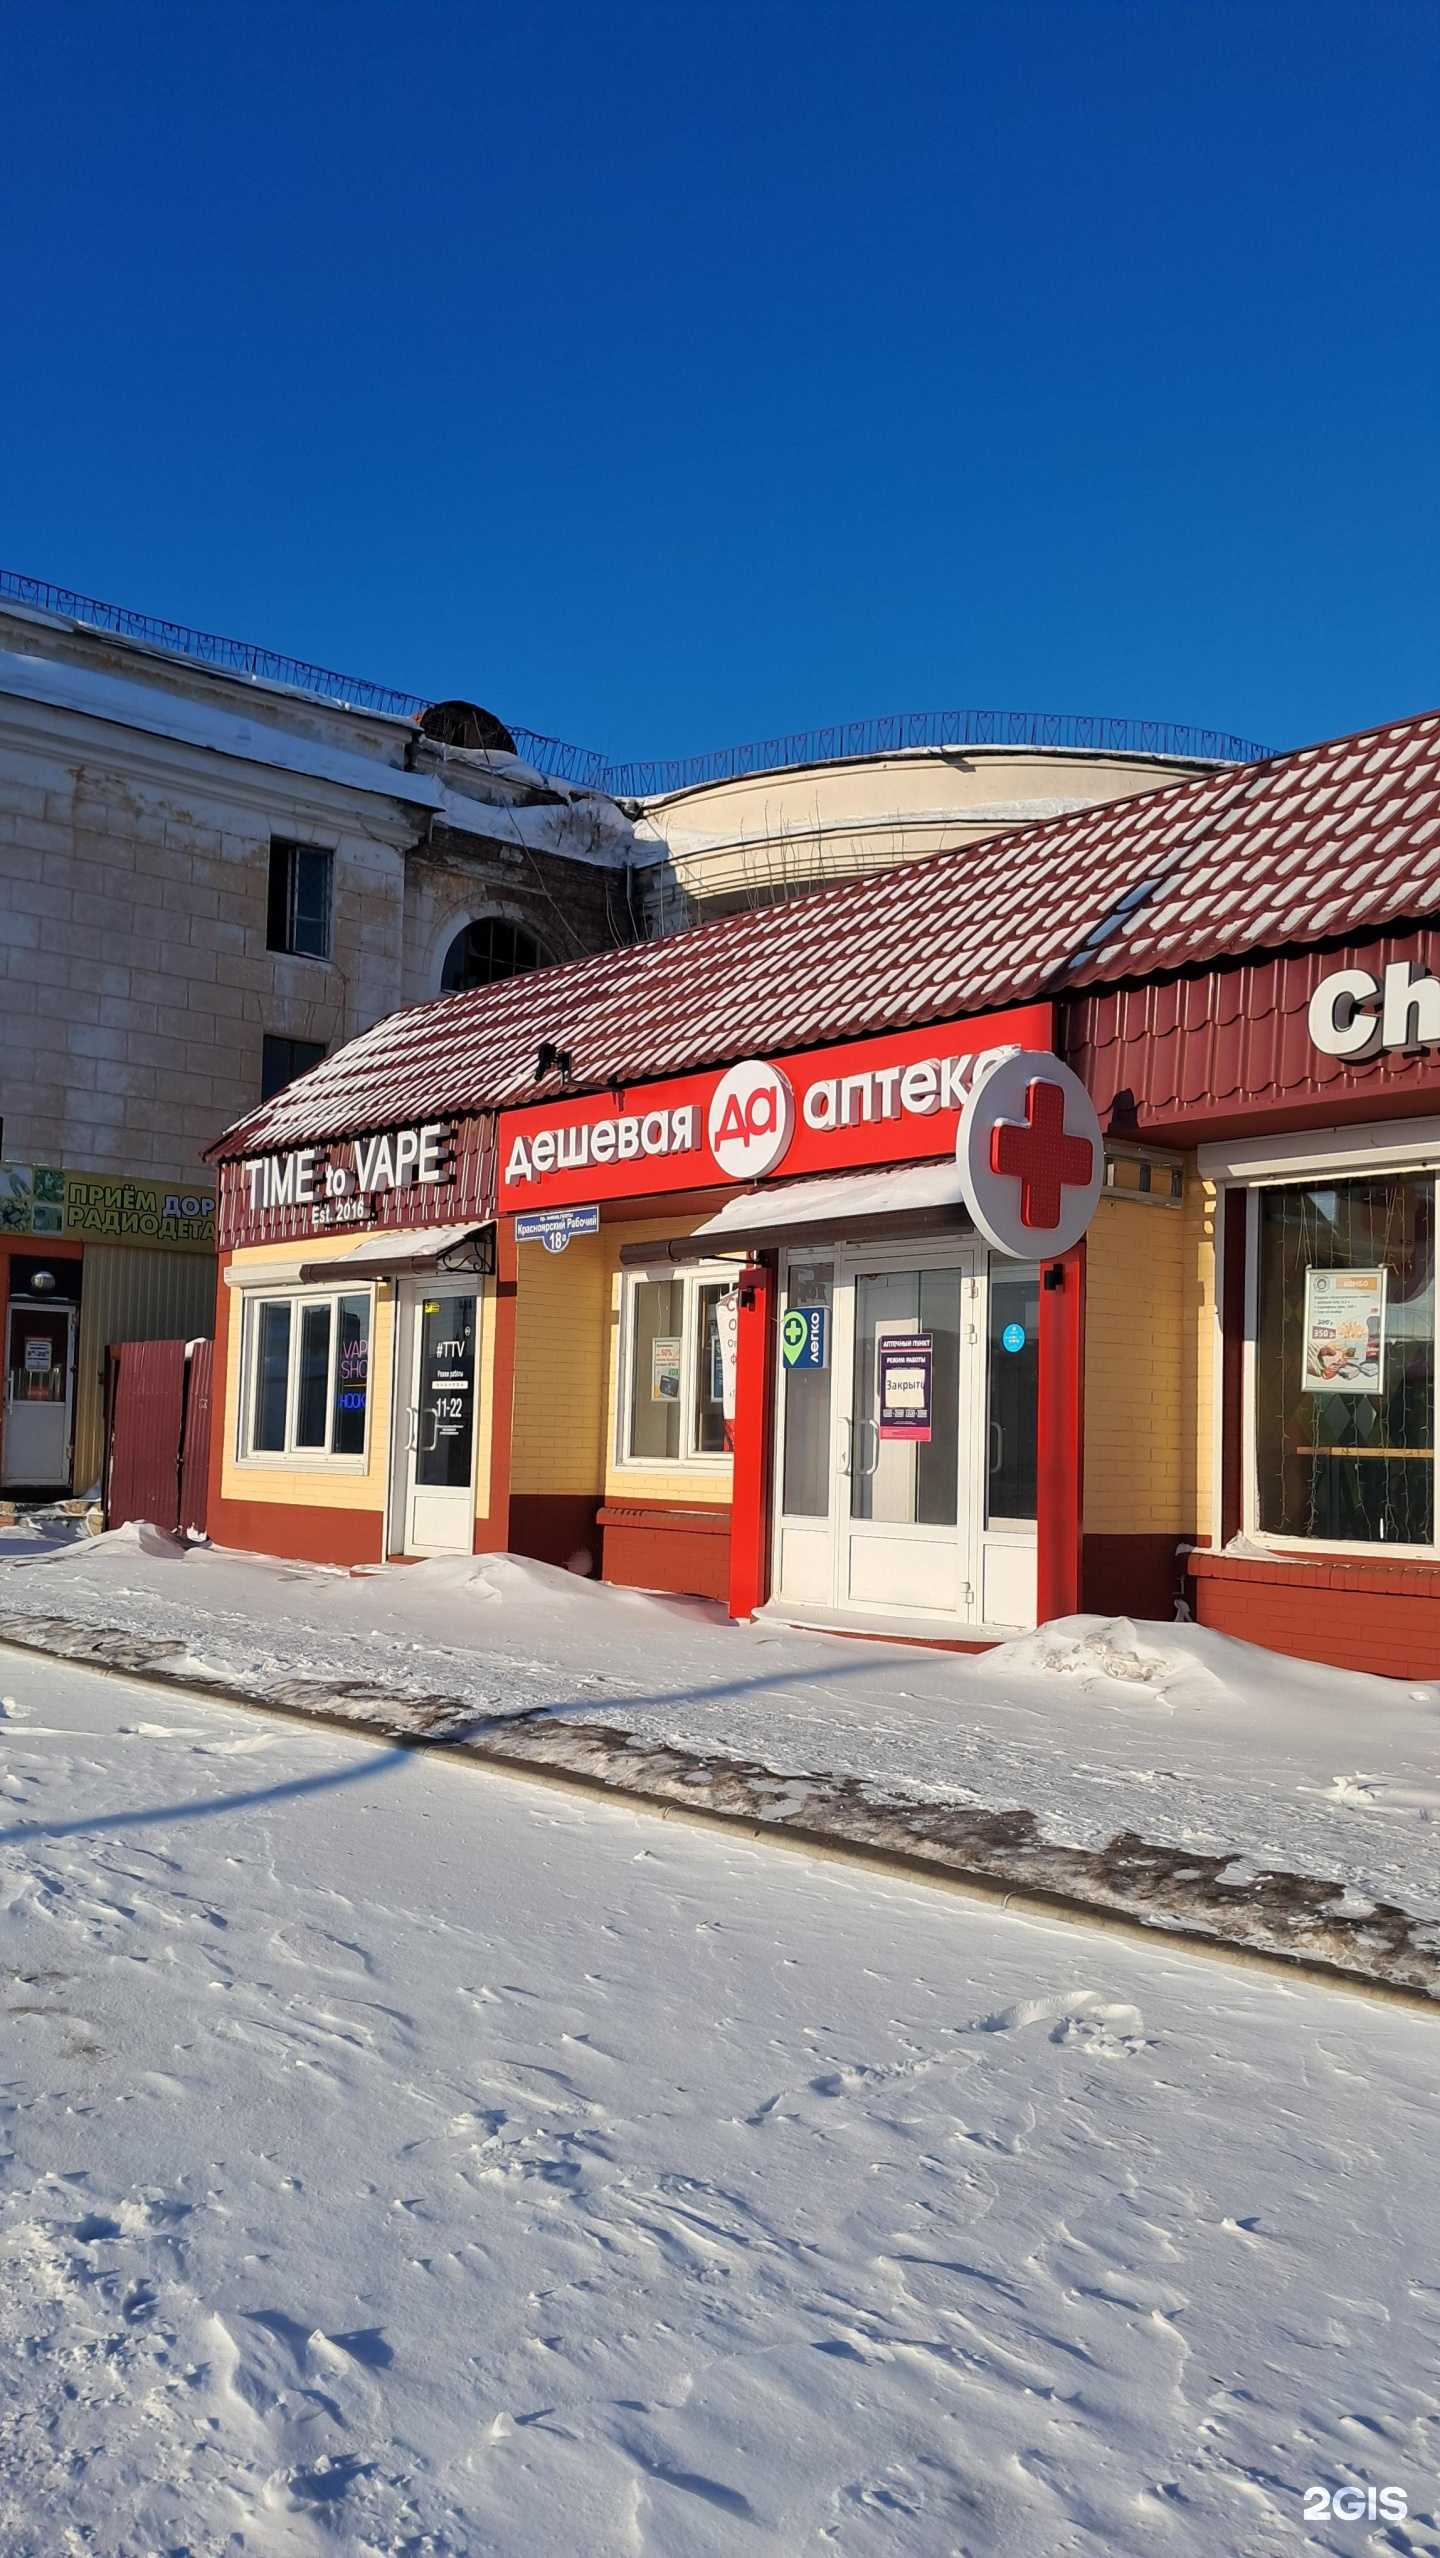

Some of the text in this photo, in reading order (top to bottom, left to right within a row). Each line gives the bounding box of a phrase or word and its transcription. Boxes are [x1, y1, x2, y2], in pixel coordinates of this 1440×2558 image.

[246, 1123, 442, 1210] TIME to VAPE
[69, 1183, 157, 1212] ПРИЁМ
[311, 1200, 365, 1225] Est. 2016
[517, 1219, 566, 1237] Красноярский
[567, 1214, 597, 1229] Рабочий
[436, 1340, 465, 1358] #TTV
[436, 1398, 463, 1417] 11-22
